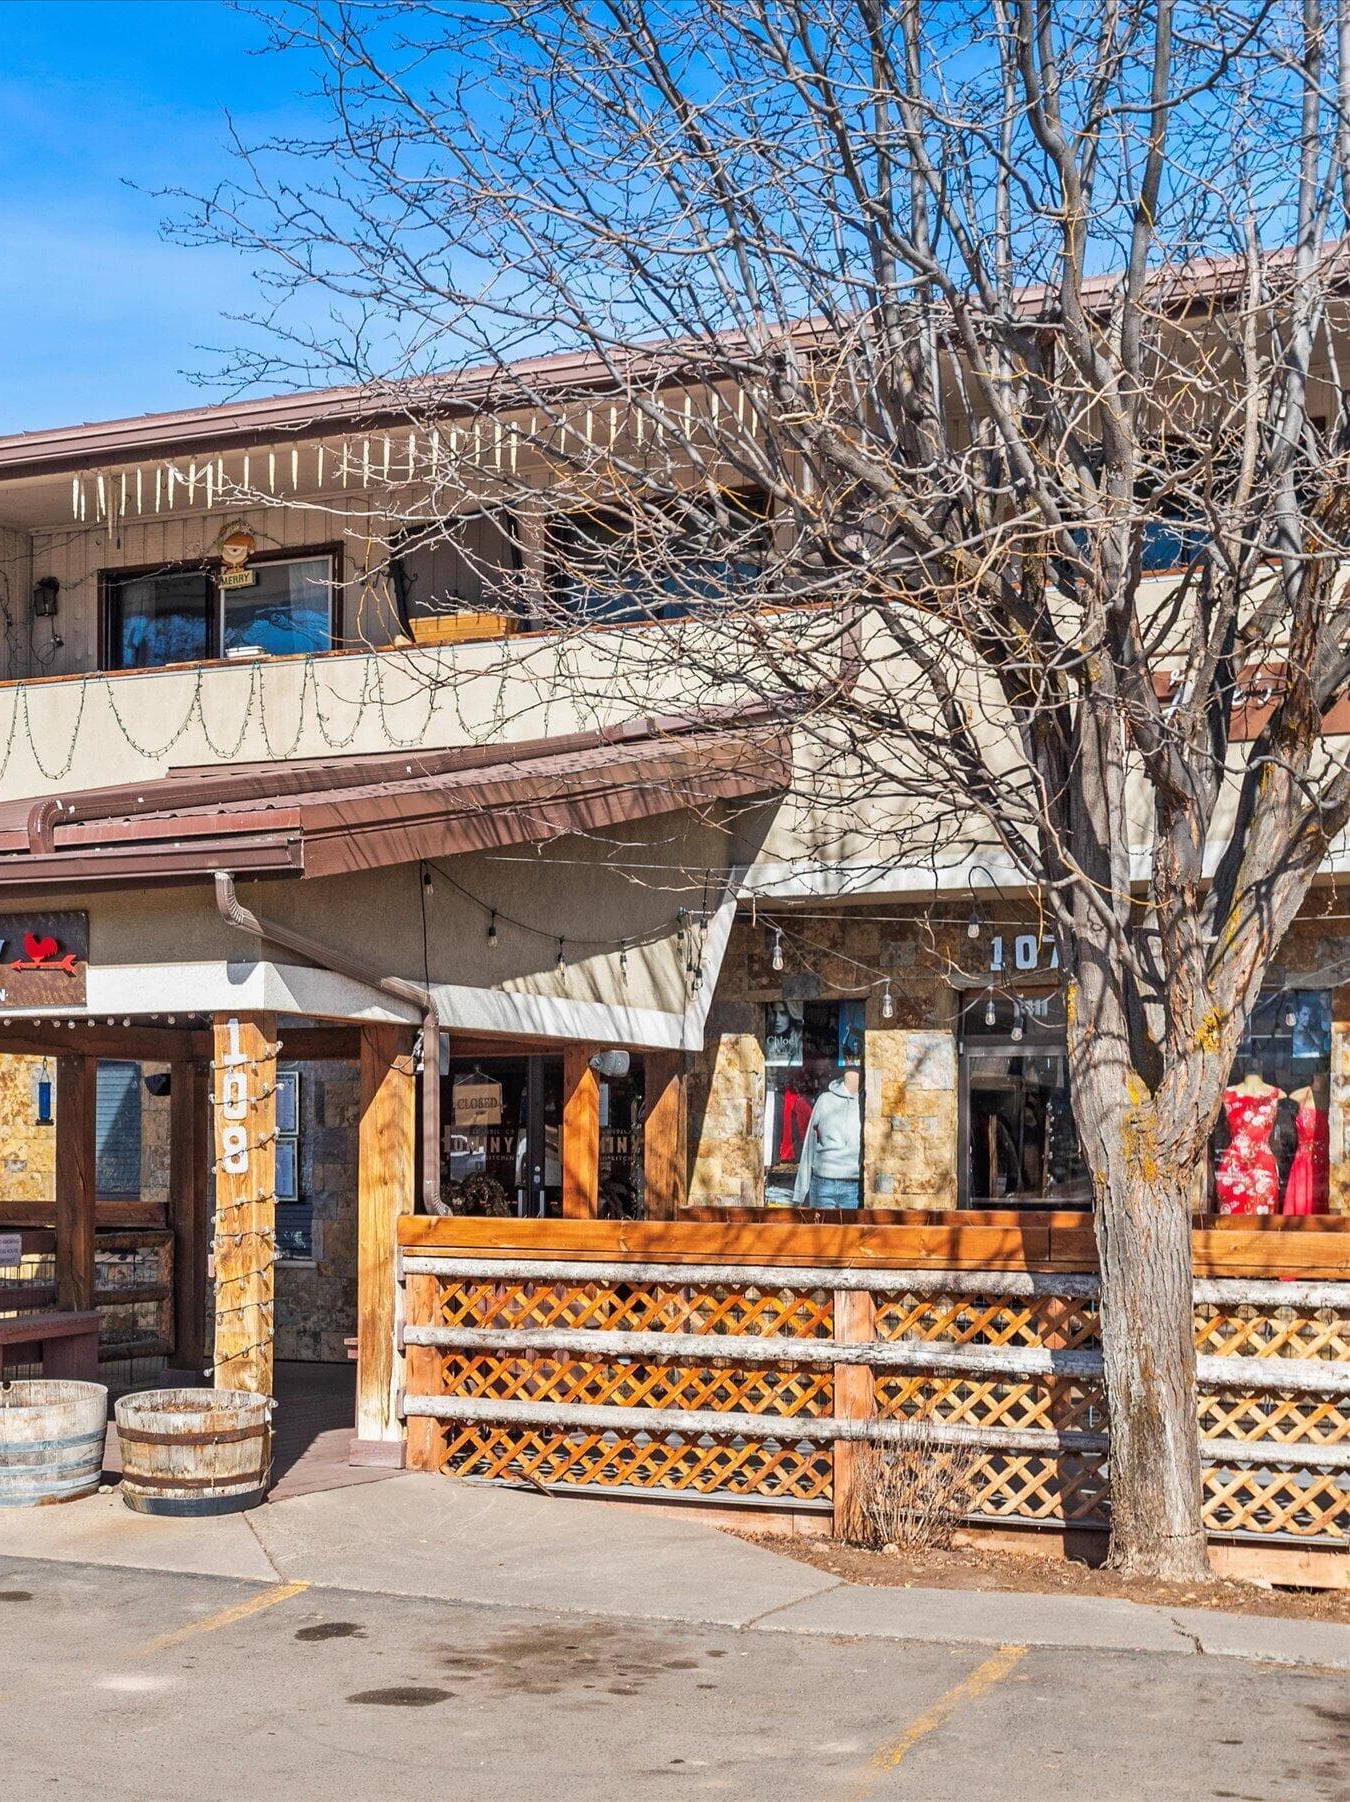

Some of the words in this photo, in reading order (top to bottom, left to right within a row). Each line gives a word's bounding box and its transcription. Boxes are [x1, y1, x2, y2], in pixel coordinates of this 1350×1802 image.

[221, 573, 250, 586] MERRY
[991, 935, 1059, 971] 107
[223, 1018, 249, 1174] 108
[457, 1097, 498, 1110] CLOSED
